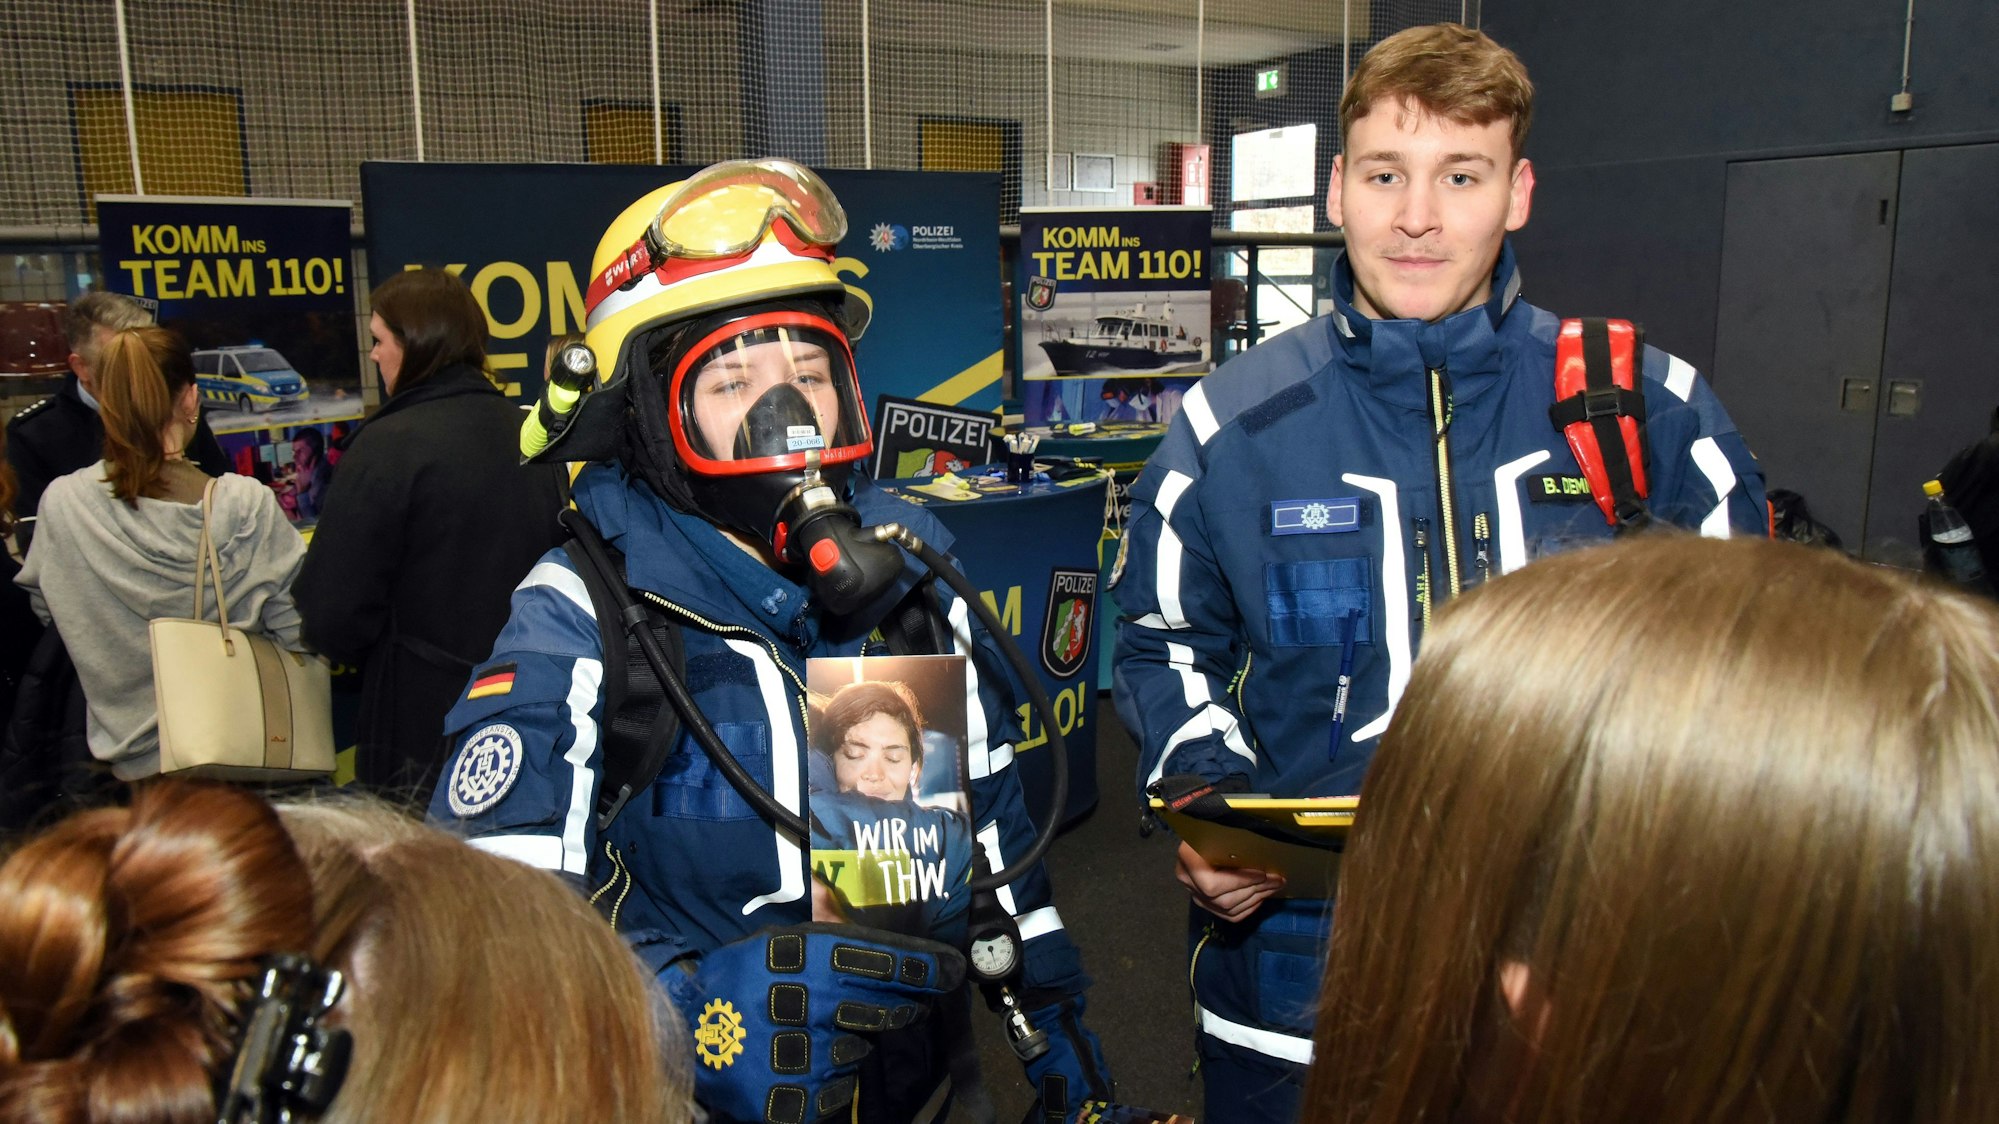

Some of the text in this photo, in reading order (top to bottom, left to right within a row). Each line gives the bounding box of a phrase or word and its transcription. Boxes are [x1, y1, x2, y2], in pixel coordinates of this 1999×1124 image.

[131, 225, 267, 254] KOMM INS
[912, 226, 954, 236] POLIZEI
[1042, 226, 1141, 249] KOMM INS
[119, 257, 345, 299] TEAM 110!
[1032, 250, 1202, 280] TEAM 110!
[890, 409, 988, 448] POLIZEI
[1542, 477, 1591, 494] B. DEM
[1056, 575, 1095, 594] POLIZEI
[1415, 573, 1425, 603] THW
[853, 818, 939, 859] WIR IM
[878, 858, 950, 907] THW.
